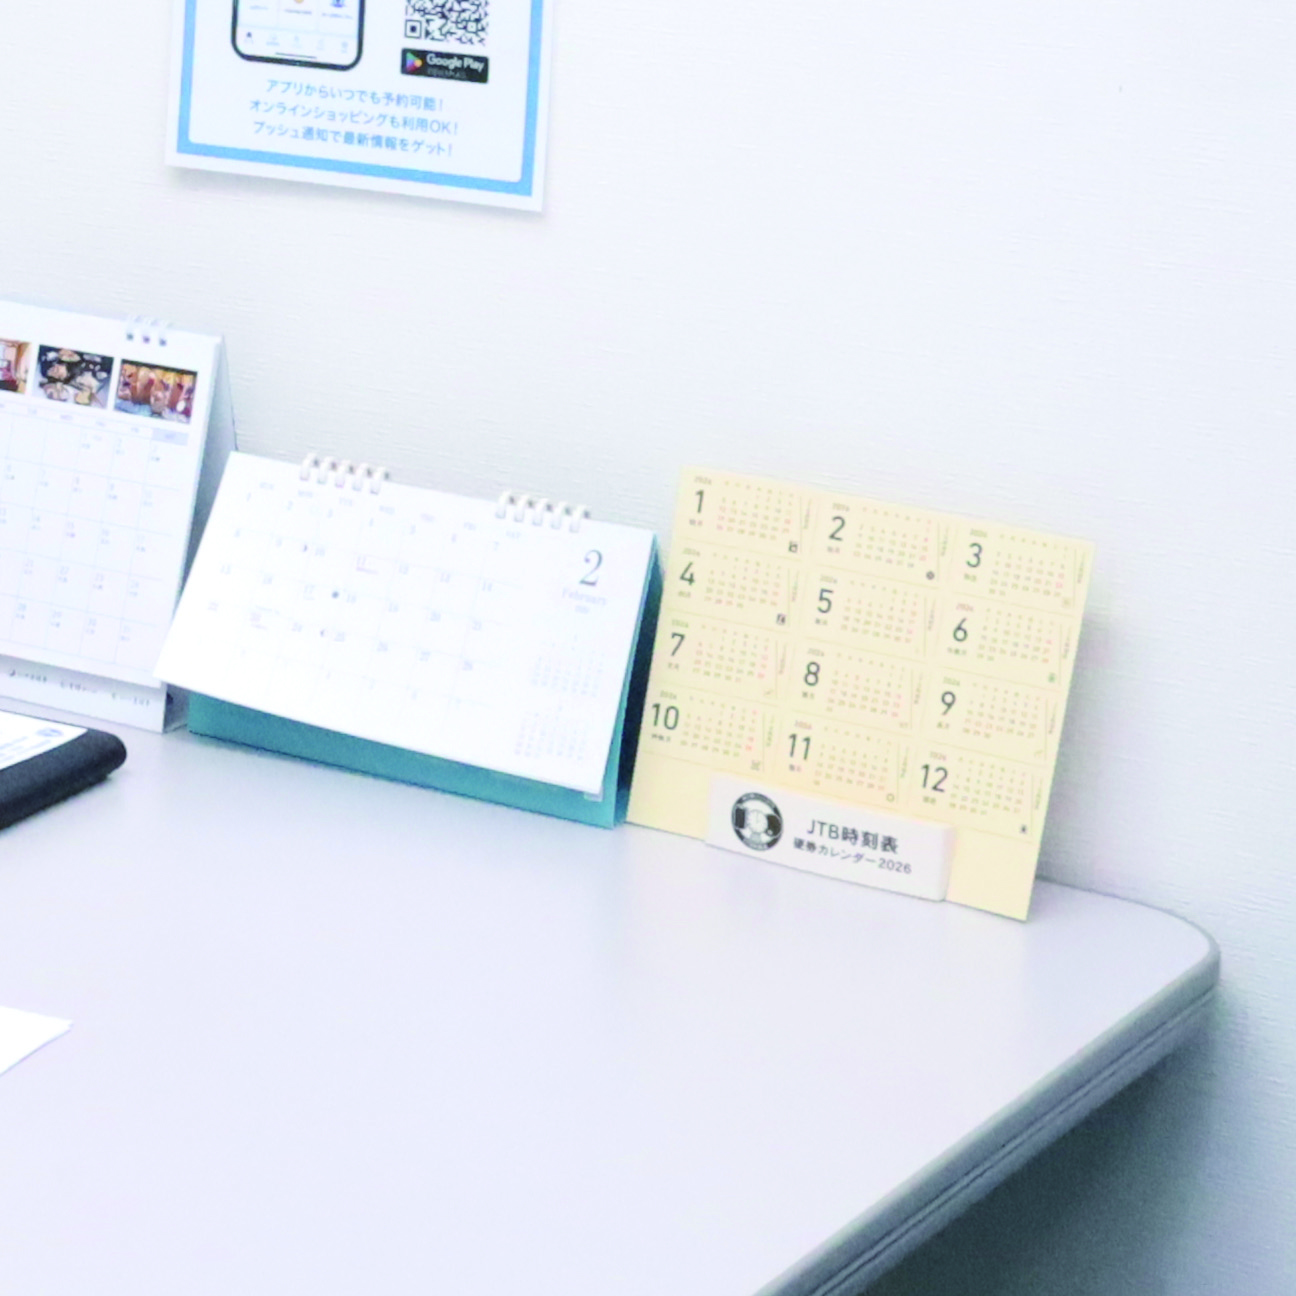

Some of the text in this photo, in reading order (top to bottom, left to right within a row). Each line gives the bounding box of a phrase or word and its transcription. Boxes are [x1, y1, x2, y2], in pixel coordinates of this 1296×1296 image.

[426, 52, 463, 70] Google
[463, 56, 485, 73] Play
[694, 488, 705, 515] 1
[827, 515, 847, 542] 2
[578, 548, 604, 588] 2
[965, 541, 984, 569] 3
[679, 560, 696, 587] 4
[816, 587, 834, 614] 5
[952, 616, 969, 643] 6
[671, 632, 686, 657] 7
[803, 660, 821, 687] 8
[651, 702, 680, 731] 10
[940, 690, 957, 717] 9
[788, 732, 811, 761] 11
[921, 763, 949, 793] 12
[806, 819, 899, 855] JTB時刻表
